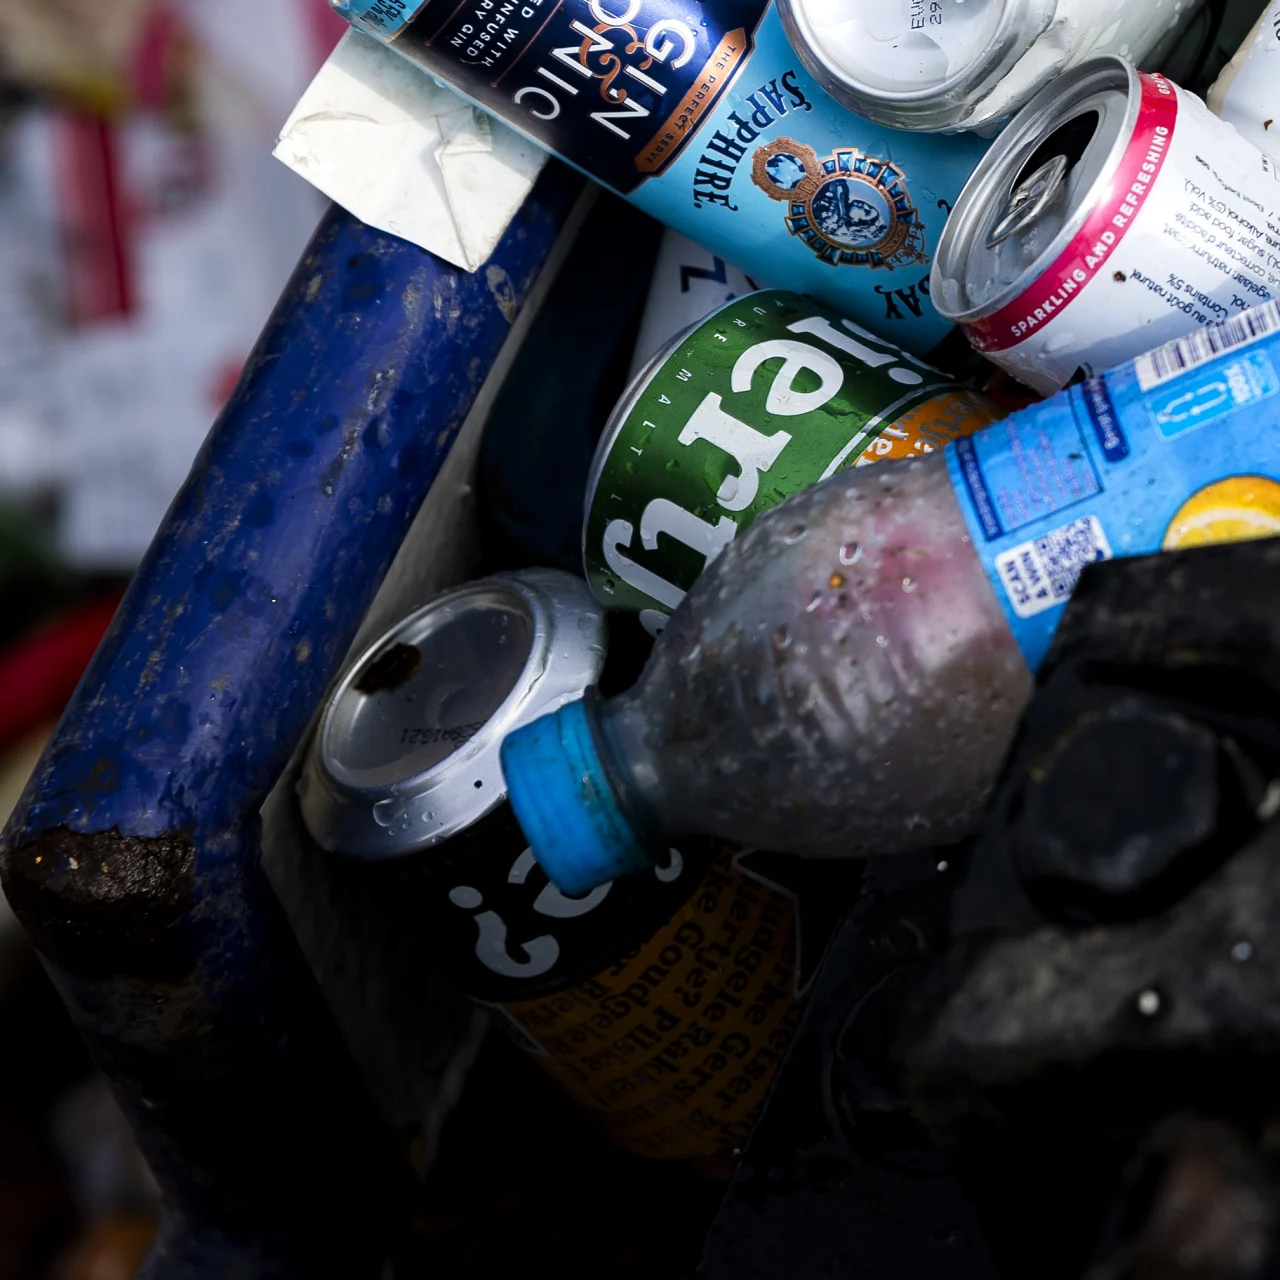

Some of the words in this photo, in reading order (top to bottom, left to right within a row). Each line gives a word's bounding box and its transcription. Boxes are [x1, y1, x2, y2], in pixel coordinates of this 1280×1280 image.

[449, 21, 474, 49] GIN
[479, 24, 518, 70] WITH
[712, 42, 737, 70] THE
[585, 8, 705, 144] GIN
[670, 73, 717, 130] PERFECT
[643, 129, 674, 165] SERVE
[693, 69, 812, 210] SAPPHIRE.
[1011, 266, 1087, 338] SPARKLING
[1085, 229, 1118, 268] AND
[1114, 123, 1170, 227] REFRESHING
[1128, 268, 1169, 300] naturel
[1165, 272, 1185, 290] 5%
[1180, 281, 1230, 319] Contains
[1165, 291, 1194, 315] goût
[1191, 307, 1208, 322] au
[712, 303, 784, 343] PURE
[628, 368, 692, 456] MALT
[1005, 561, 1030, 602] SCAN
